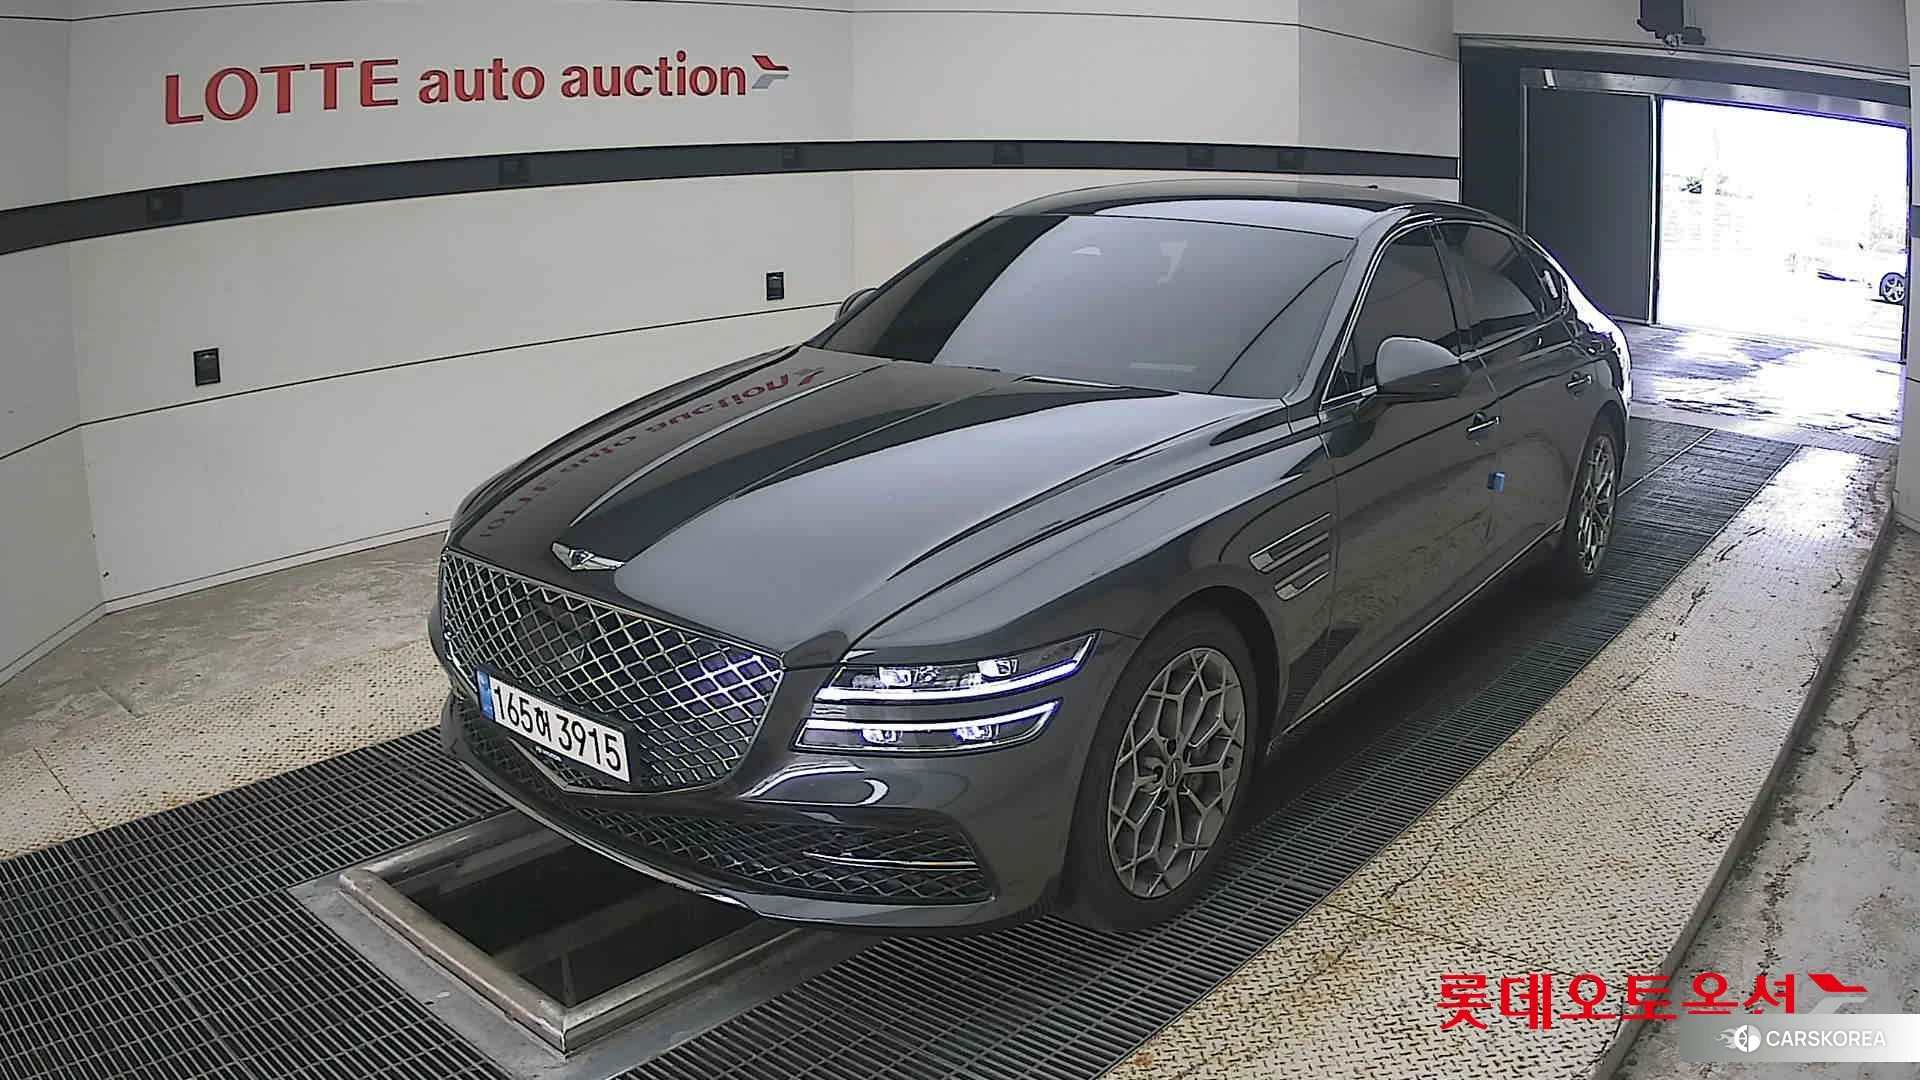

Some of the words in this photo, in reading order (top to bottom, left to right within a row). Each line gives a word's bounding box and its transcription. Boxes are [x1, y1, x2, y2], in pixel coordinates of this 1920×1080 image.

[165, 59, 399, 125] LOTTE
[418, 57, 545, 105] auto
[560, 50, 748, 98] auction
[556, 713, 622, 772] 3915
